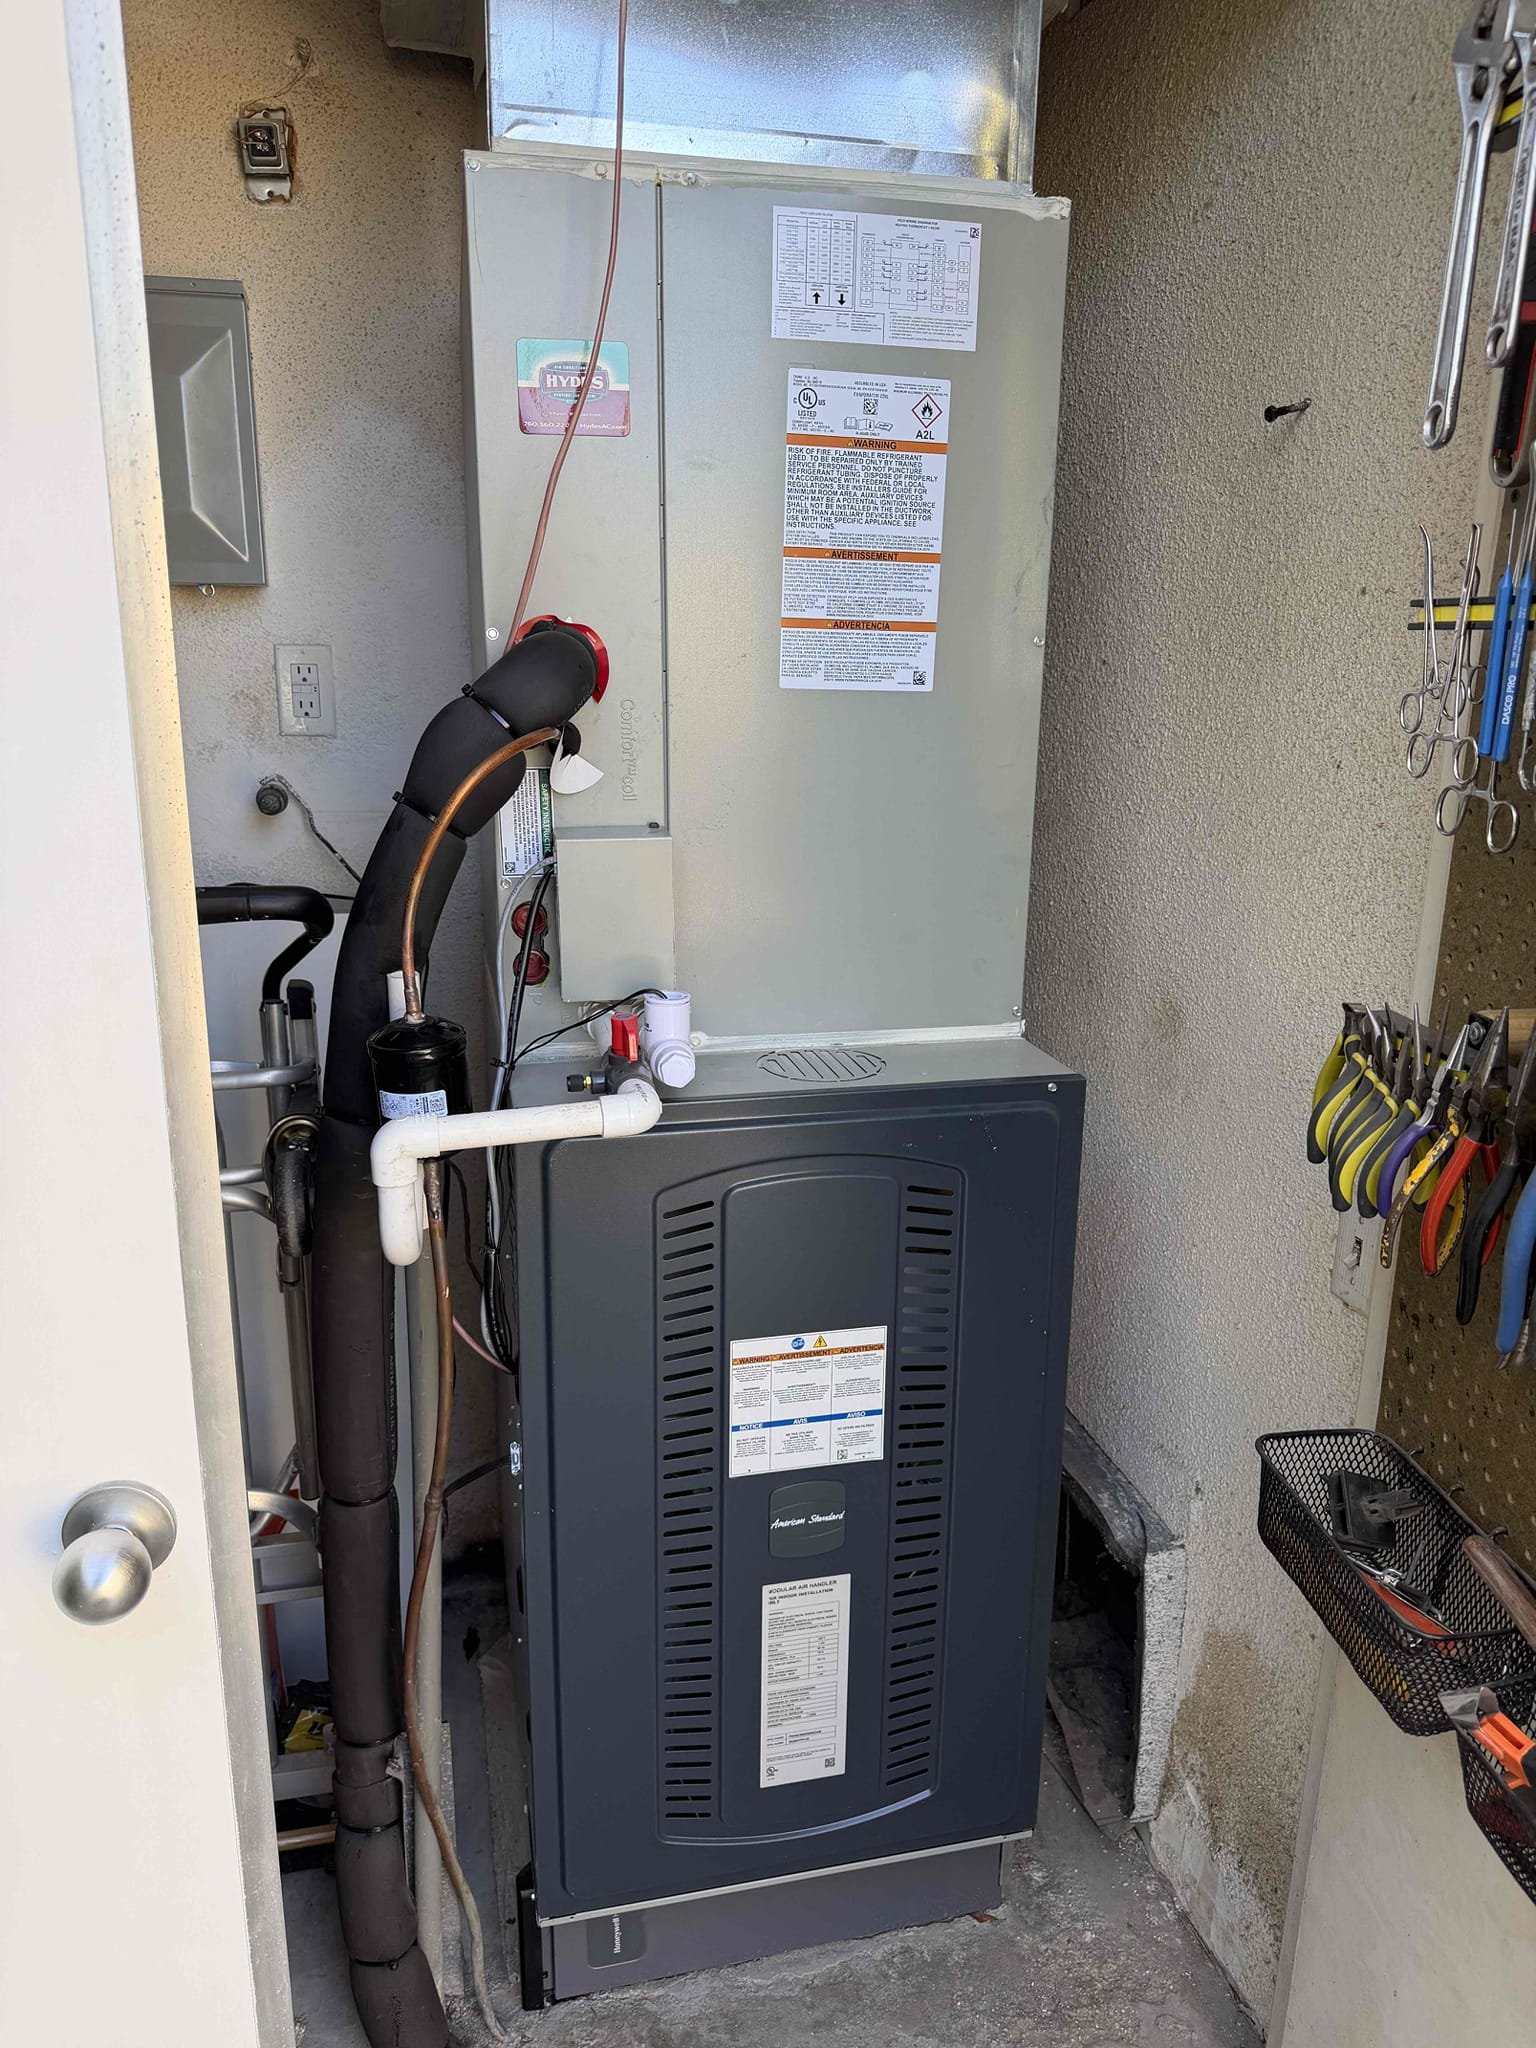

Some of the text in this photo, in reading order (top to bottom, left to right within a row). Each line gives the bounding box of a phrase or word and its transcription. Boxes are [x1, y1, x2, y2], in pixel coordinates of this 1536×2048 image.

[797, 409, 816, 417] LISTED
[915, 430, 934, 440] A2L
[853, 439, 896, 449] WARNING
[834, 450, 874, 458] FLAMMABLE
[876, 452, 922, 461] REFRIGERANT
[787, 460, 816, 468] SERVICE
[888, 466, 922, 474] PUNCTURE
[831, 456, 863, 464] REPAIRED
[894, 460, 922, 468] TRAINED
[787, 467, 834, 476] REFRIGERANT
[904, 474, 938, 482] PROPERLY
[795, 474, 842, 483] ACCORDANCE
[861, 478, 891, 486] FEDERAL
[786, 487, 816, 495] MINIMUM
[860, 491, 894, 499] AUXILIARY
[851, 484, 890, 492] INSTALLERS
[892, 486, 912, 494] GUIDE
[842, 497, 878, 505] POTENTIAL
[786, 507, 808, 515] OTHER
[830, 510, 863, 518] AUXILIARY
[836, 503, 871, 511] INSTALLED
[833, 516, 863, 524] SPECIFIC
[831, 550, 898, 561] AVERTISSEMENT
[832, 619, 890, 630] ADVERTENCIA
[1501, 674, 1517, 725] DASCO PRO
[739, 1344, 884, 1364] WARNING AVERTISSEMENT ADVERTENCIA
[739, 1422, 762, 1430] NOTICE
[846, 1410, 865, 1418] AVISO
[769, 1510, 845, 1530] American Standard
[809, 1579, 837, 1588] HANDLER
[612, 1917, 622, 1954] Honeywell
